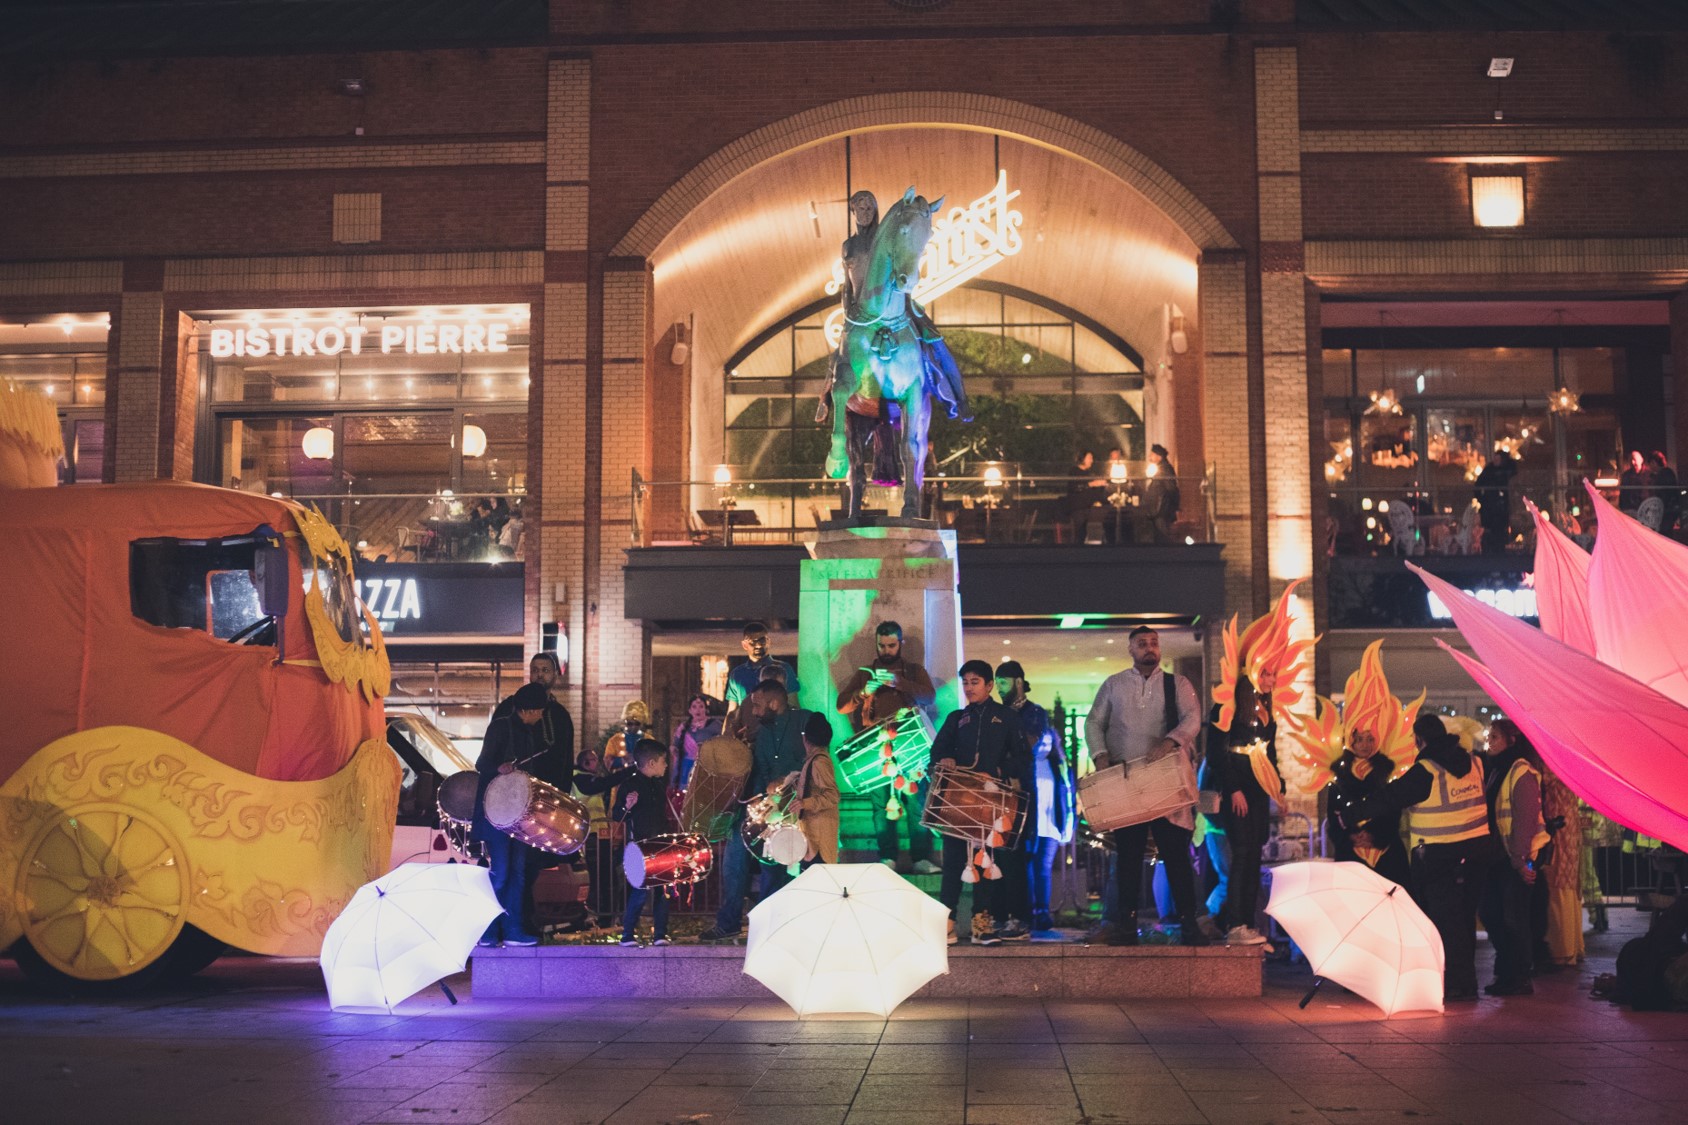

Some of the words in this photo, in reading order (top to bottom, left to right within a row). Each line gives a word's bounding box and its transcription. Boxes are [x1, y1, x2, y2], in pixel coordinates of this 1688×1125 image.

[210, 326, 367, 357] BISTROT
[381, 323, 509, 354] PIERRE
[354, 578, 421, 618] IZZA
